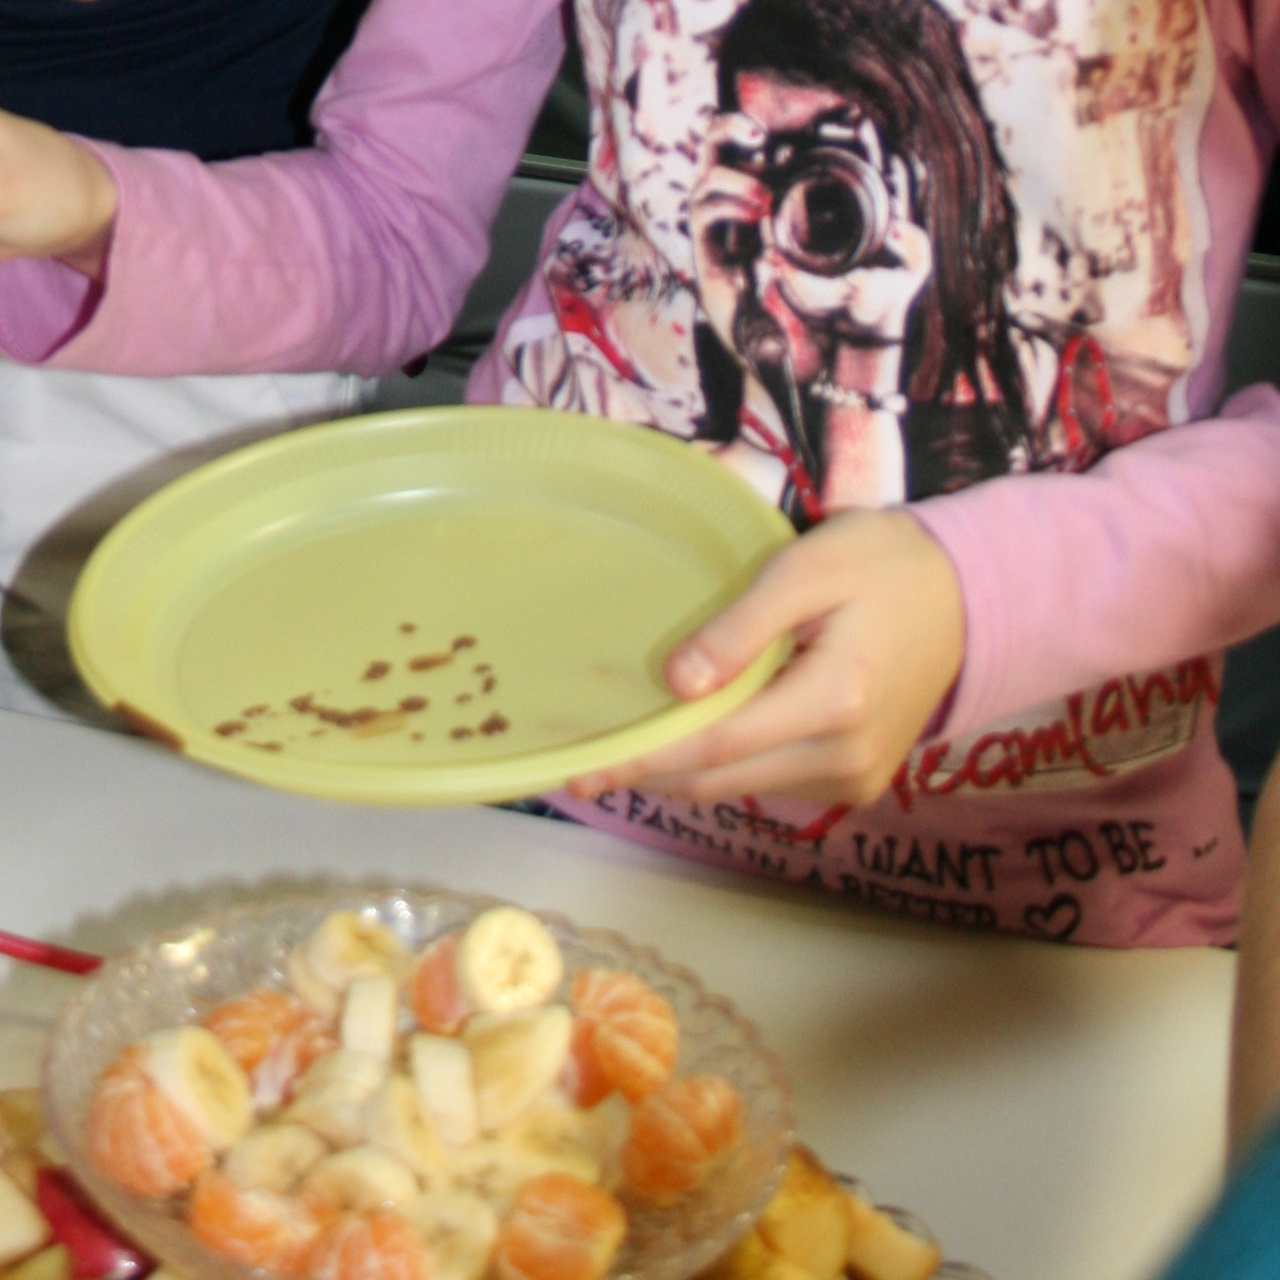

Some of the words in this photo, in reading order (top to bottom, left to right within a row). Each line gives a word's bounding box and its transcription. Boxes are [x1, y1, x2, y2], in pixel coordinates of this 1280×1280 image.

[853, 834, 1002, 890] WANT
[1027, 829, 1096, 886] TO
[1100, 821, 1166, 875] BE
